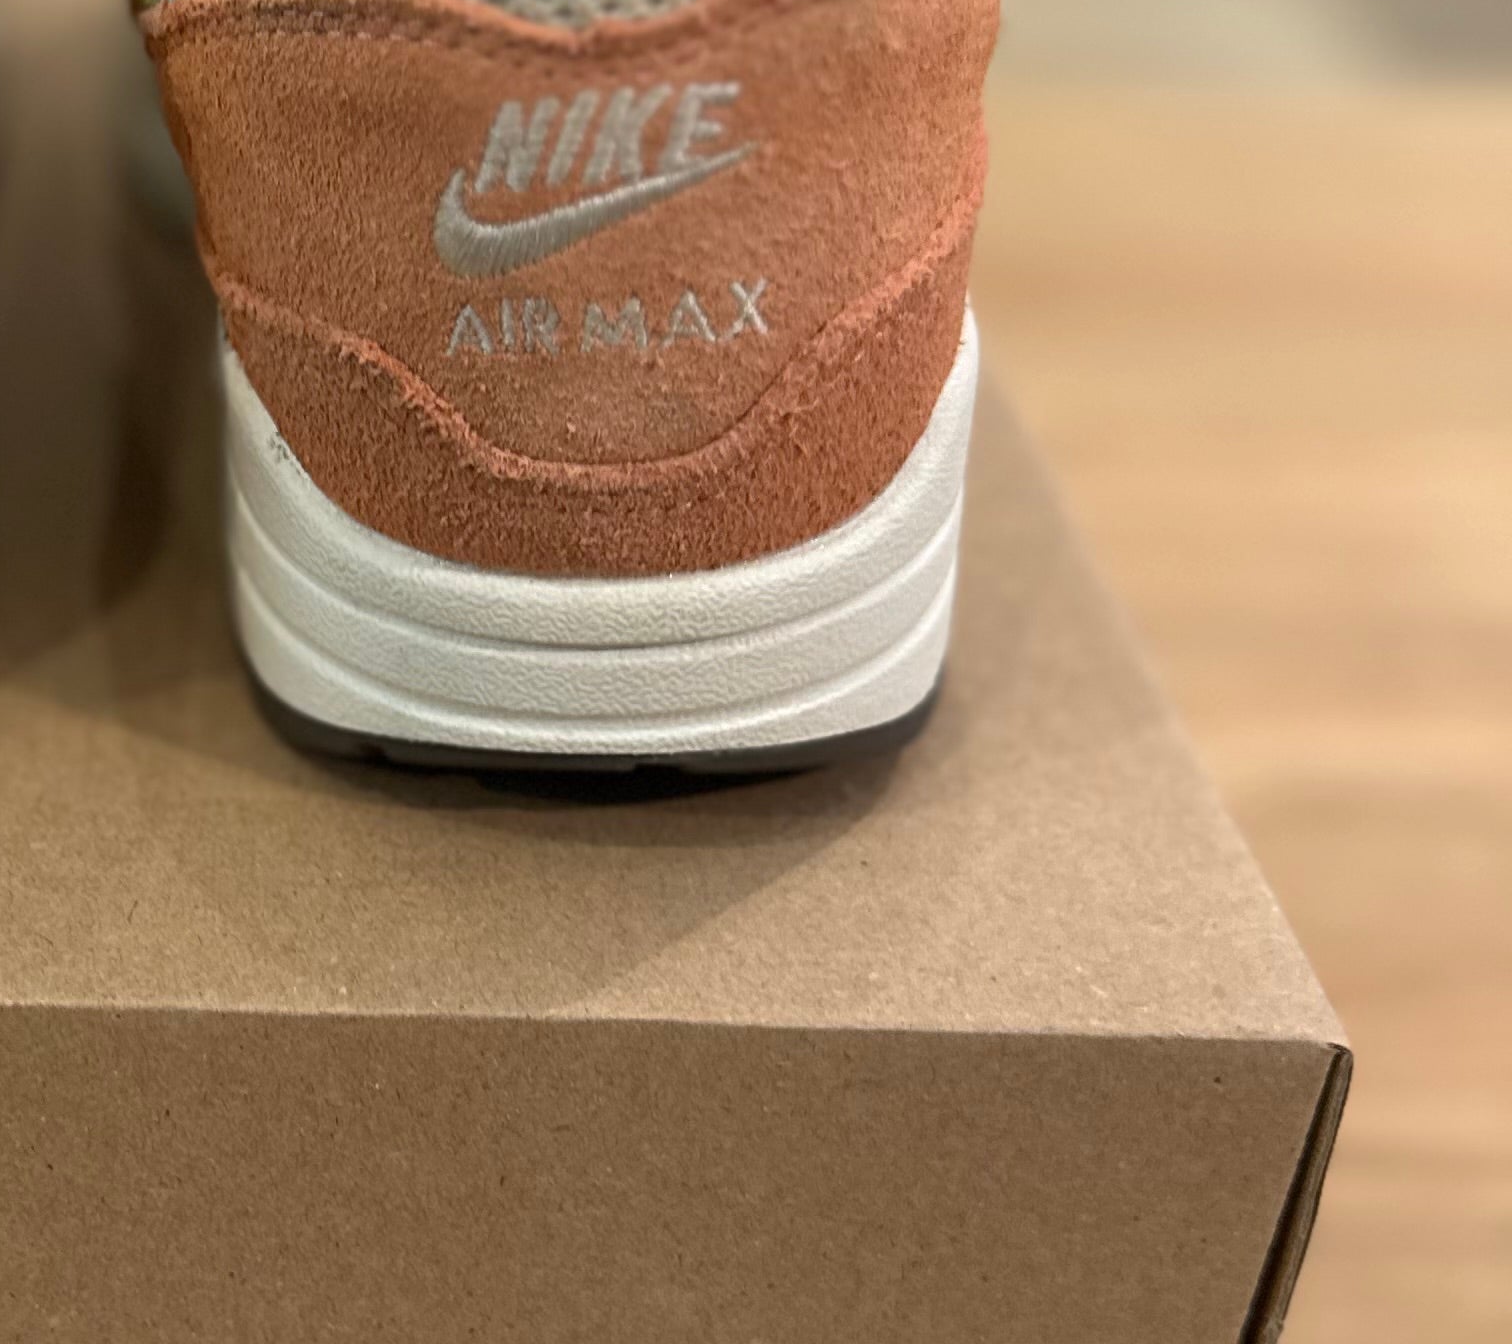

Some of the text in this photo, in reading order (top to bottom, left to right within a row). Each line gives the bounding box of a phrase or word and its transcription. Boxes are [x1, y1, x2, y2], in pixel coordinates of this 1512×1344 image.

[474, 80, 740, 192] NIKE
[446, 278, 769, 357] AIR MAX
